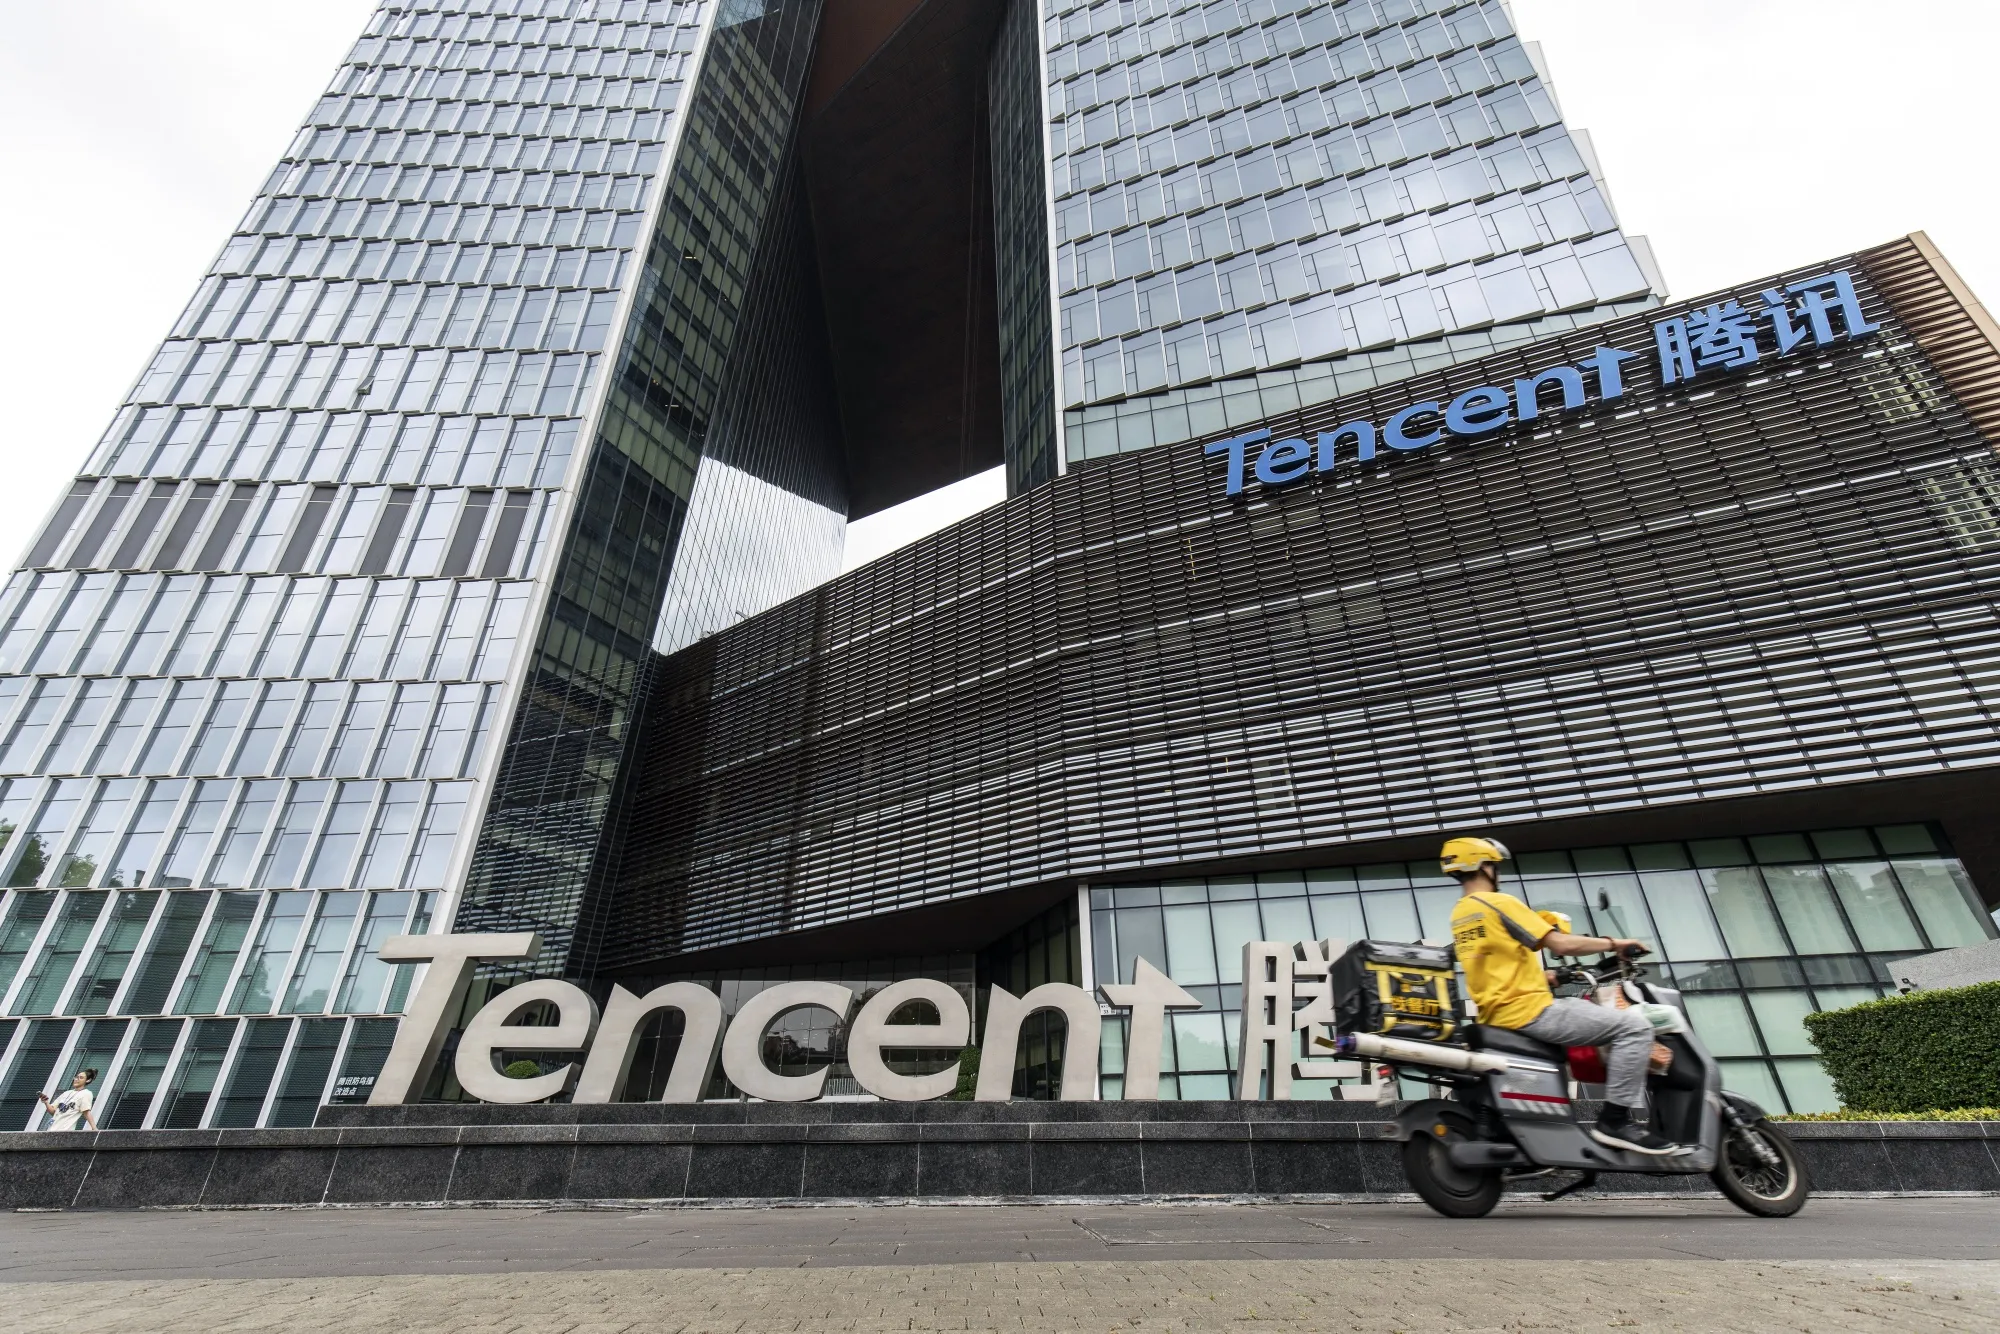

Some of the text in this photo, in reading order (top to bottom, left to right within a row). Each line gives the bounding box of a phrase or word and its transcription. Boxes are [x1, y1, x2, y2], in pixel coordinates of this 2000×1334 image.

[1654, 270, 1881, 388] 腾讯
[1203, 346, 1640, 498] Tencent
[366, 931, 1204, 1105] Tencent
